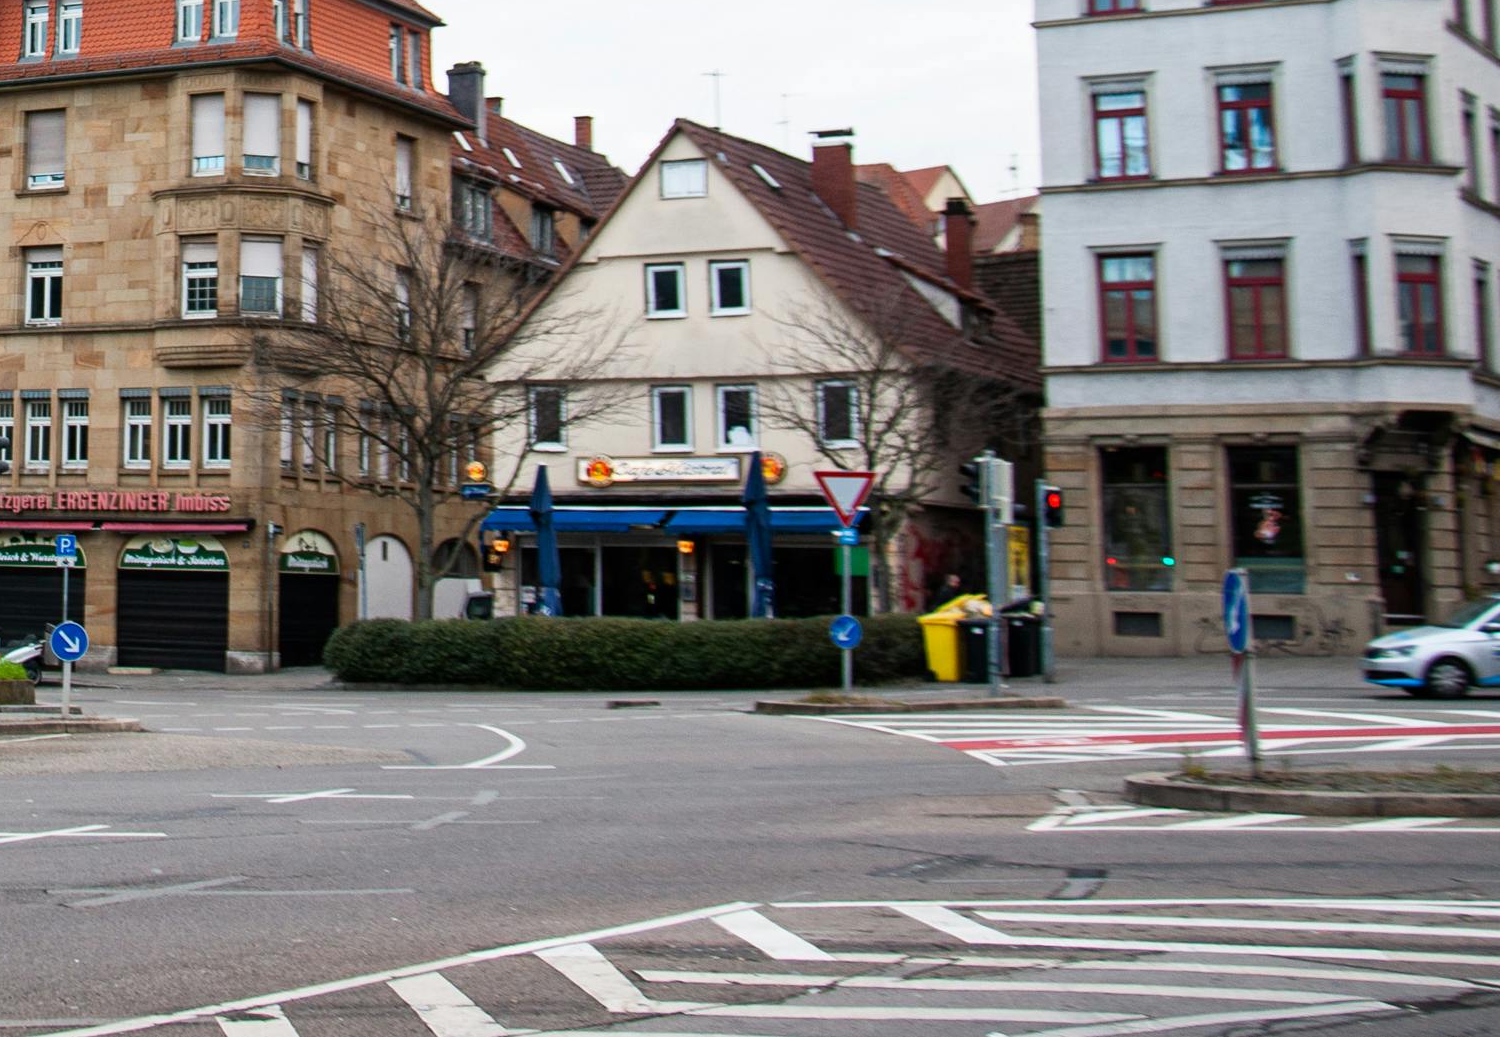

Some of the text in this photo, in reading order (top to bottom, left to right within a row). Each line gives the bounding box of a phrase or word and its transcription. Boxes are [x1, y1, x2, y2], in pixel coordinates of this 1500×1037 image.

[57, 491, 170, 511] ERGENZINGER
[175, 493, 230, 512] Imbiss
[60, 538, 71, 553] P
